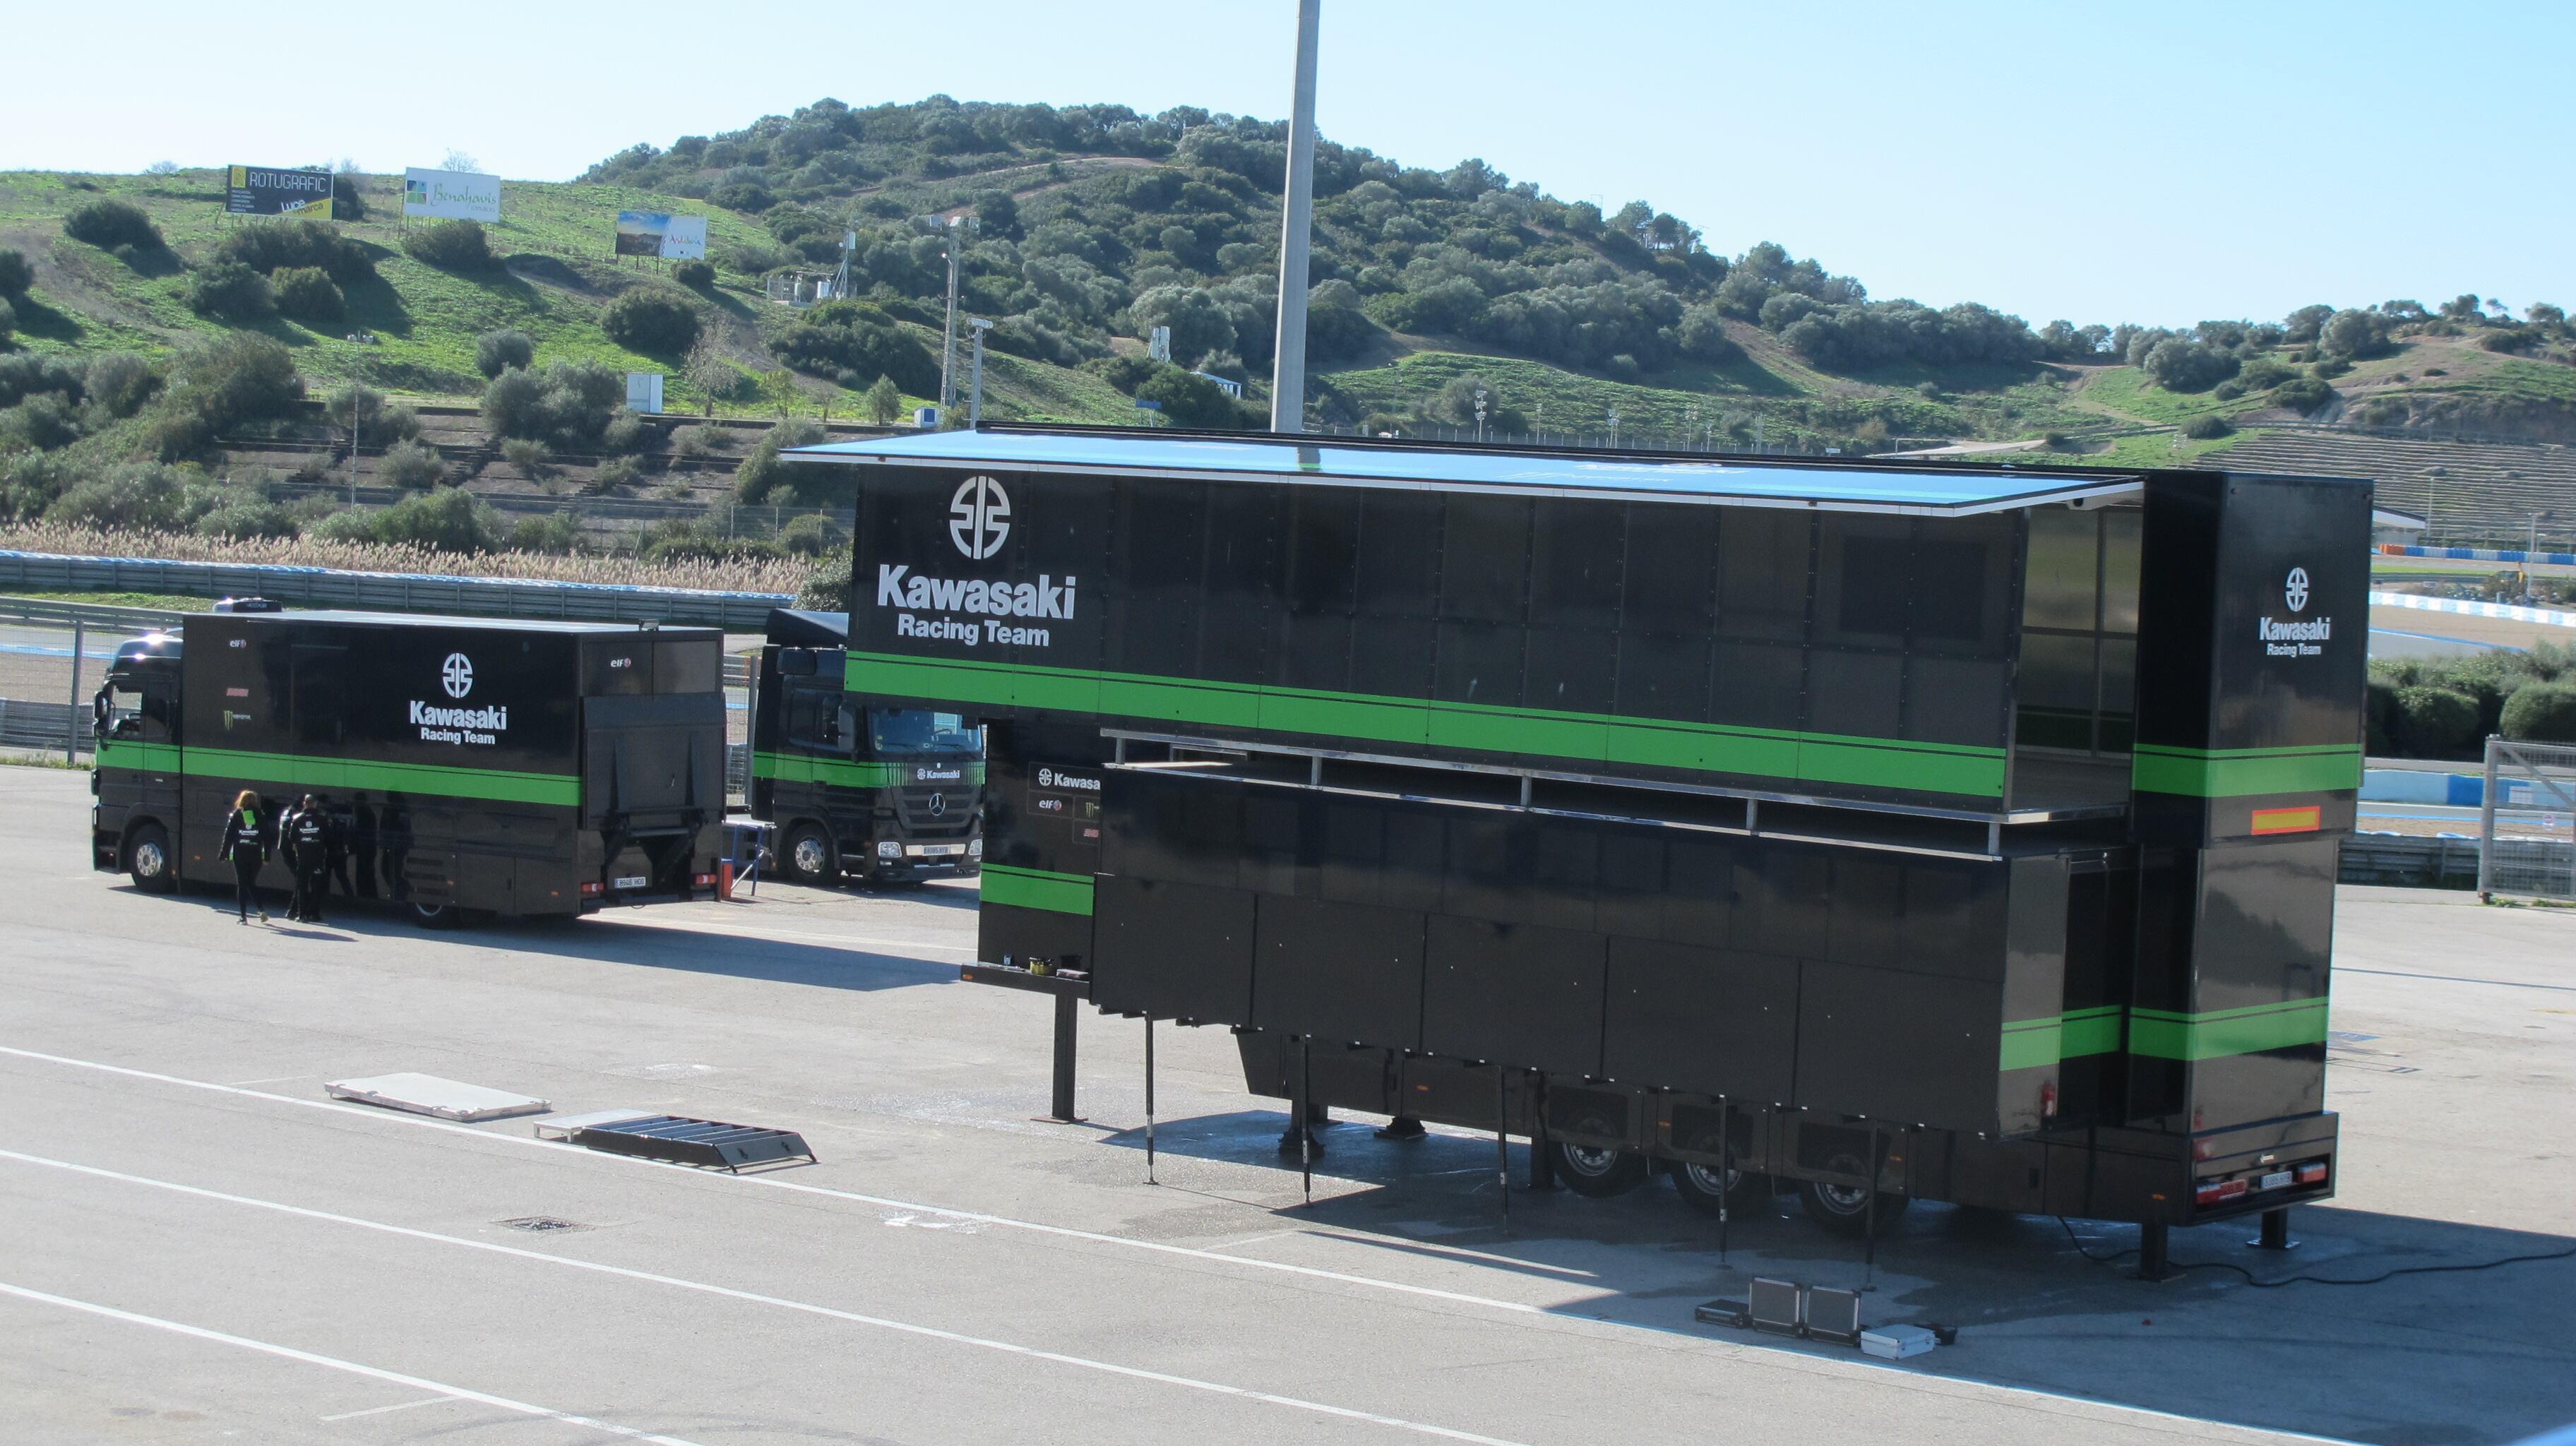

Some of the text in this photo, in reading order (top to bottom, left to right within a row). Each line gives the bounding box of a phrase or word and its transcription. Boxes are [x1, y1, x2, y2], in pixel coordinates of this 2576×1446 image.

[249, 172, 326, 192] ROTUGRAFIC
[877, 563, 1076, 619] Kawasaki
[898, 614, 1049, 647] Racing Team
[2260, 616, 2330, 640] Kawasaki
[2267, 643, 2322, 658] Racing Team
[610, 659, 624, 668] elf
[410, 700, 507, 730] Kawasaki
[420, 727, 496, 745] Racing Team
[926, 770, 960, 779] Kawasaki
[1054, 772, 1101, 791] Kawasa
[1039, 800, 1054, 809] elf
